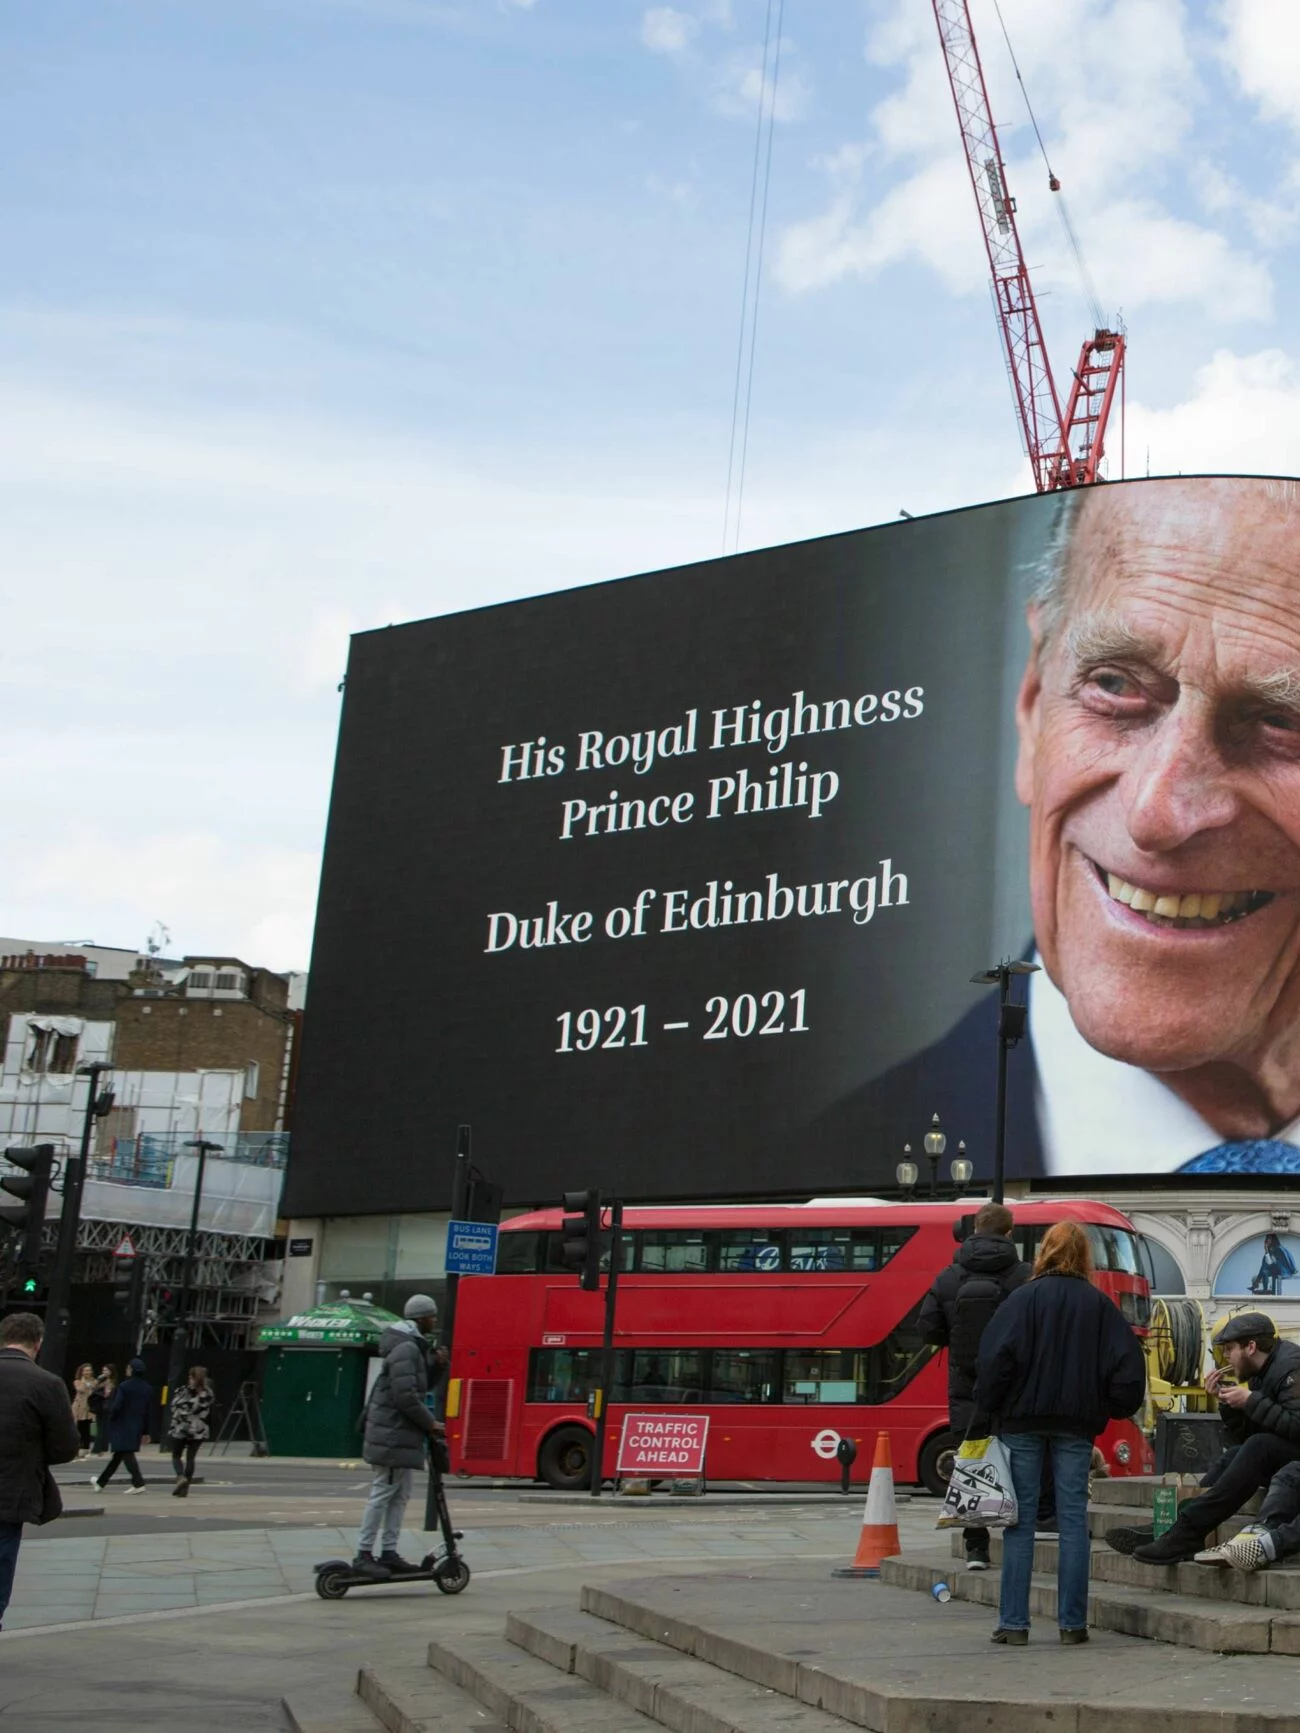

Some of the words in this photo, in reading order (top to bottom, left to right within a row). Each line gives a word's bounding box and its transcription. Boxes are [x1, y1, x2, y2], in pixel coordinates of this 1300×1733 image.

[497, 736, 566, 783] His
[575, 709, 698, 775] Royal
[708, 685, 925, 755] Highness
[558, 790, 695, 840] Prince
[705, 761, 840, 819] Philip
[483, 900, 593, 953] Duke
[605, 888, 656, 939] of
[660, 859, 910, 933] Edinburgh
[554, 1004, 649, 1053] 1921
[702, 988, 810, 1040] 2021
[453, 1224, 471, 1234] BUS
[472, 1225, 493, 1236] LANE
[448, 1252, 469, 1261] LOOK
[471, 1253, 493, 1262] BOTH
[459, 1262, 481, 1272] WAYS
[636, 1422, 699, 1435] TRAFFIC
[629, 1436, 700, 1449] CONTROL
[636, 1451, 689, 1463] AHEAD
